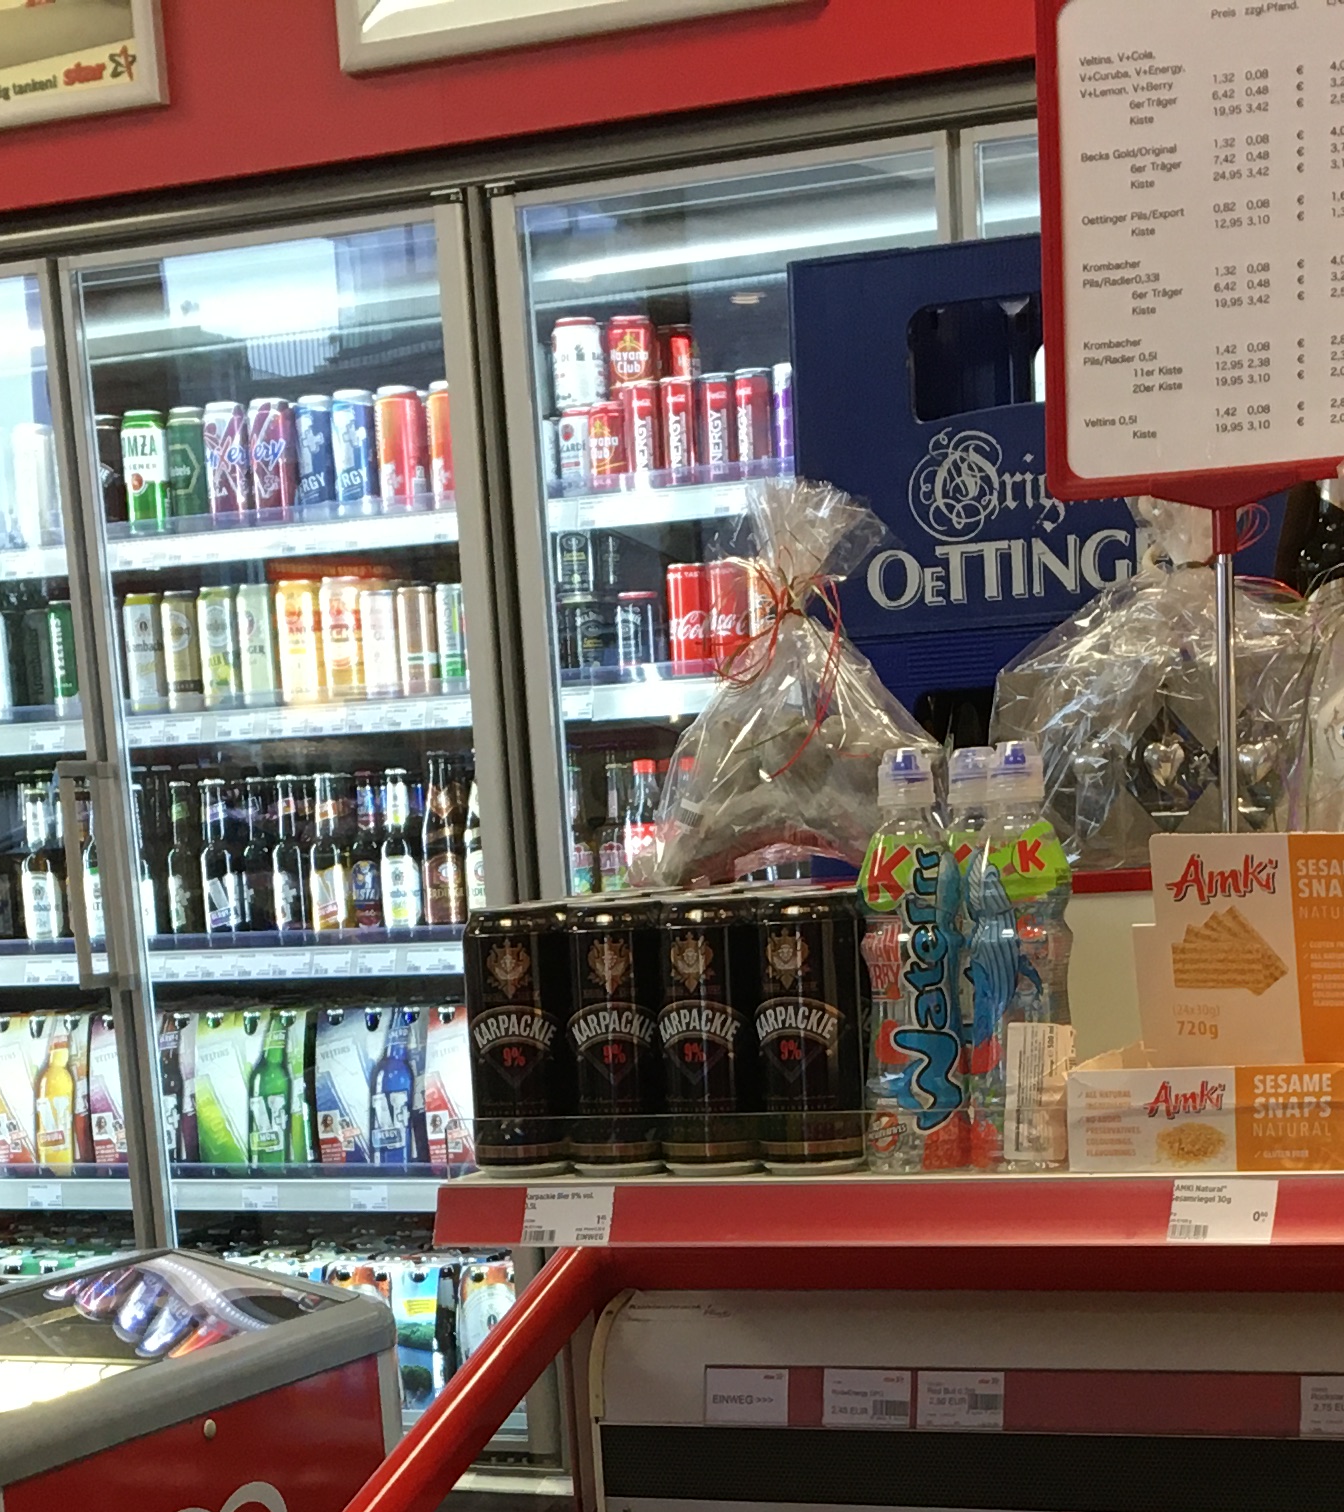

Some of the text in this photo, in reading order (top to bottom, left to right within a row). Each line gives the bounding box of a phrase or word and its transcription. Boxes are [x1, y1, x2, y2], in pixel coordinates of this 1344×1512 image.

[1211, 9, 1236, 19] Preis
[12, 75, 58, 96] tanken!
[63, 62, 106, 86] star
[1132, 81, 1173, 94] V+Berry
[1129, 115, 1154, 126] Kiste
[1080, 144, 1178, 163] Becks Gold/Original
[1130, 160, 1182, 174] 6er Träger
[1130, 179, 1155, 190] Kiste
[1081, 208, 1185, 227] Oettinger Pils/Export
[1131, 226, 1156, 237] Kiste
[1082, 259, 1141, 272] Krombacher
[1131, 286, 1183, 300] 6er Träger
[1131, 305, 1156, 316] Kiste
[1083, 338, 1142, 350] Krombacher
[617, 360, 641, 374] Club
[1083, 354, 1135, 367] Pils/Radler
[1133, 365, 1183, 378] 11er Kiste
[1132, 381, 1183, 394] 20er Kiste
[1084, 416, 1116, 428] Veltins
[1132, 429, 1157, 440] Kiste
[1018, 839, 1047, 873] K
[1166, 853, 1278, 905] Amki
[473, 1010, 557, 1050] KARPACKIE
[571, 1006, 656, 1046] KARPACKIE
[658, 1008, 741, 1046] KARPACKIE
[756, 1005, 838, 1043] KARPACKIE
[1177, 1020, 1219, 1039] 720g
[503, 1046, 526, 1067] 9%
[603, 1043, 626, 1064] 9%
[684, 1042, 706, 1063] 9%
[780, 1039, 802, 1060] 9%
[1253, 1073, 1332, 1094] SESAME
[1143, 1080, 1225, 1120] Amki
[1253, 1095, 1332, 1119] SNAPS
[1252, 1119, 1332, 1137] NATURAL
[1217, 1196, 1232, 1204] 30g
[712, 1394, 753, 1405] EINWEG
